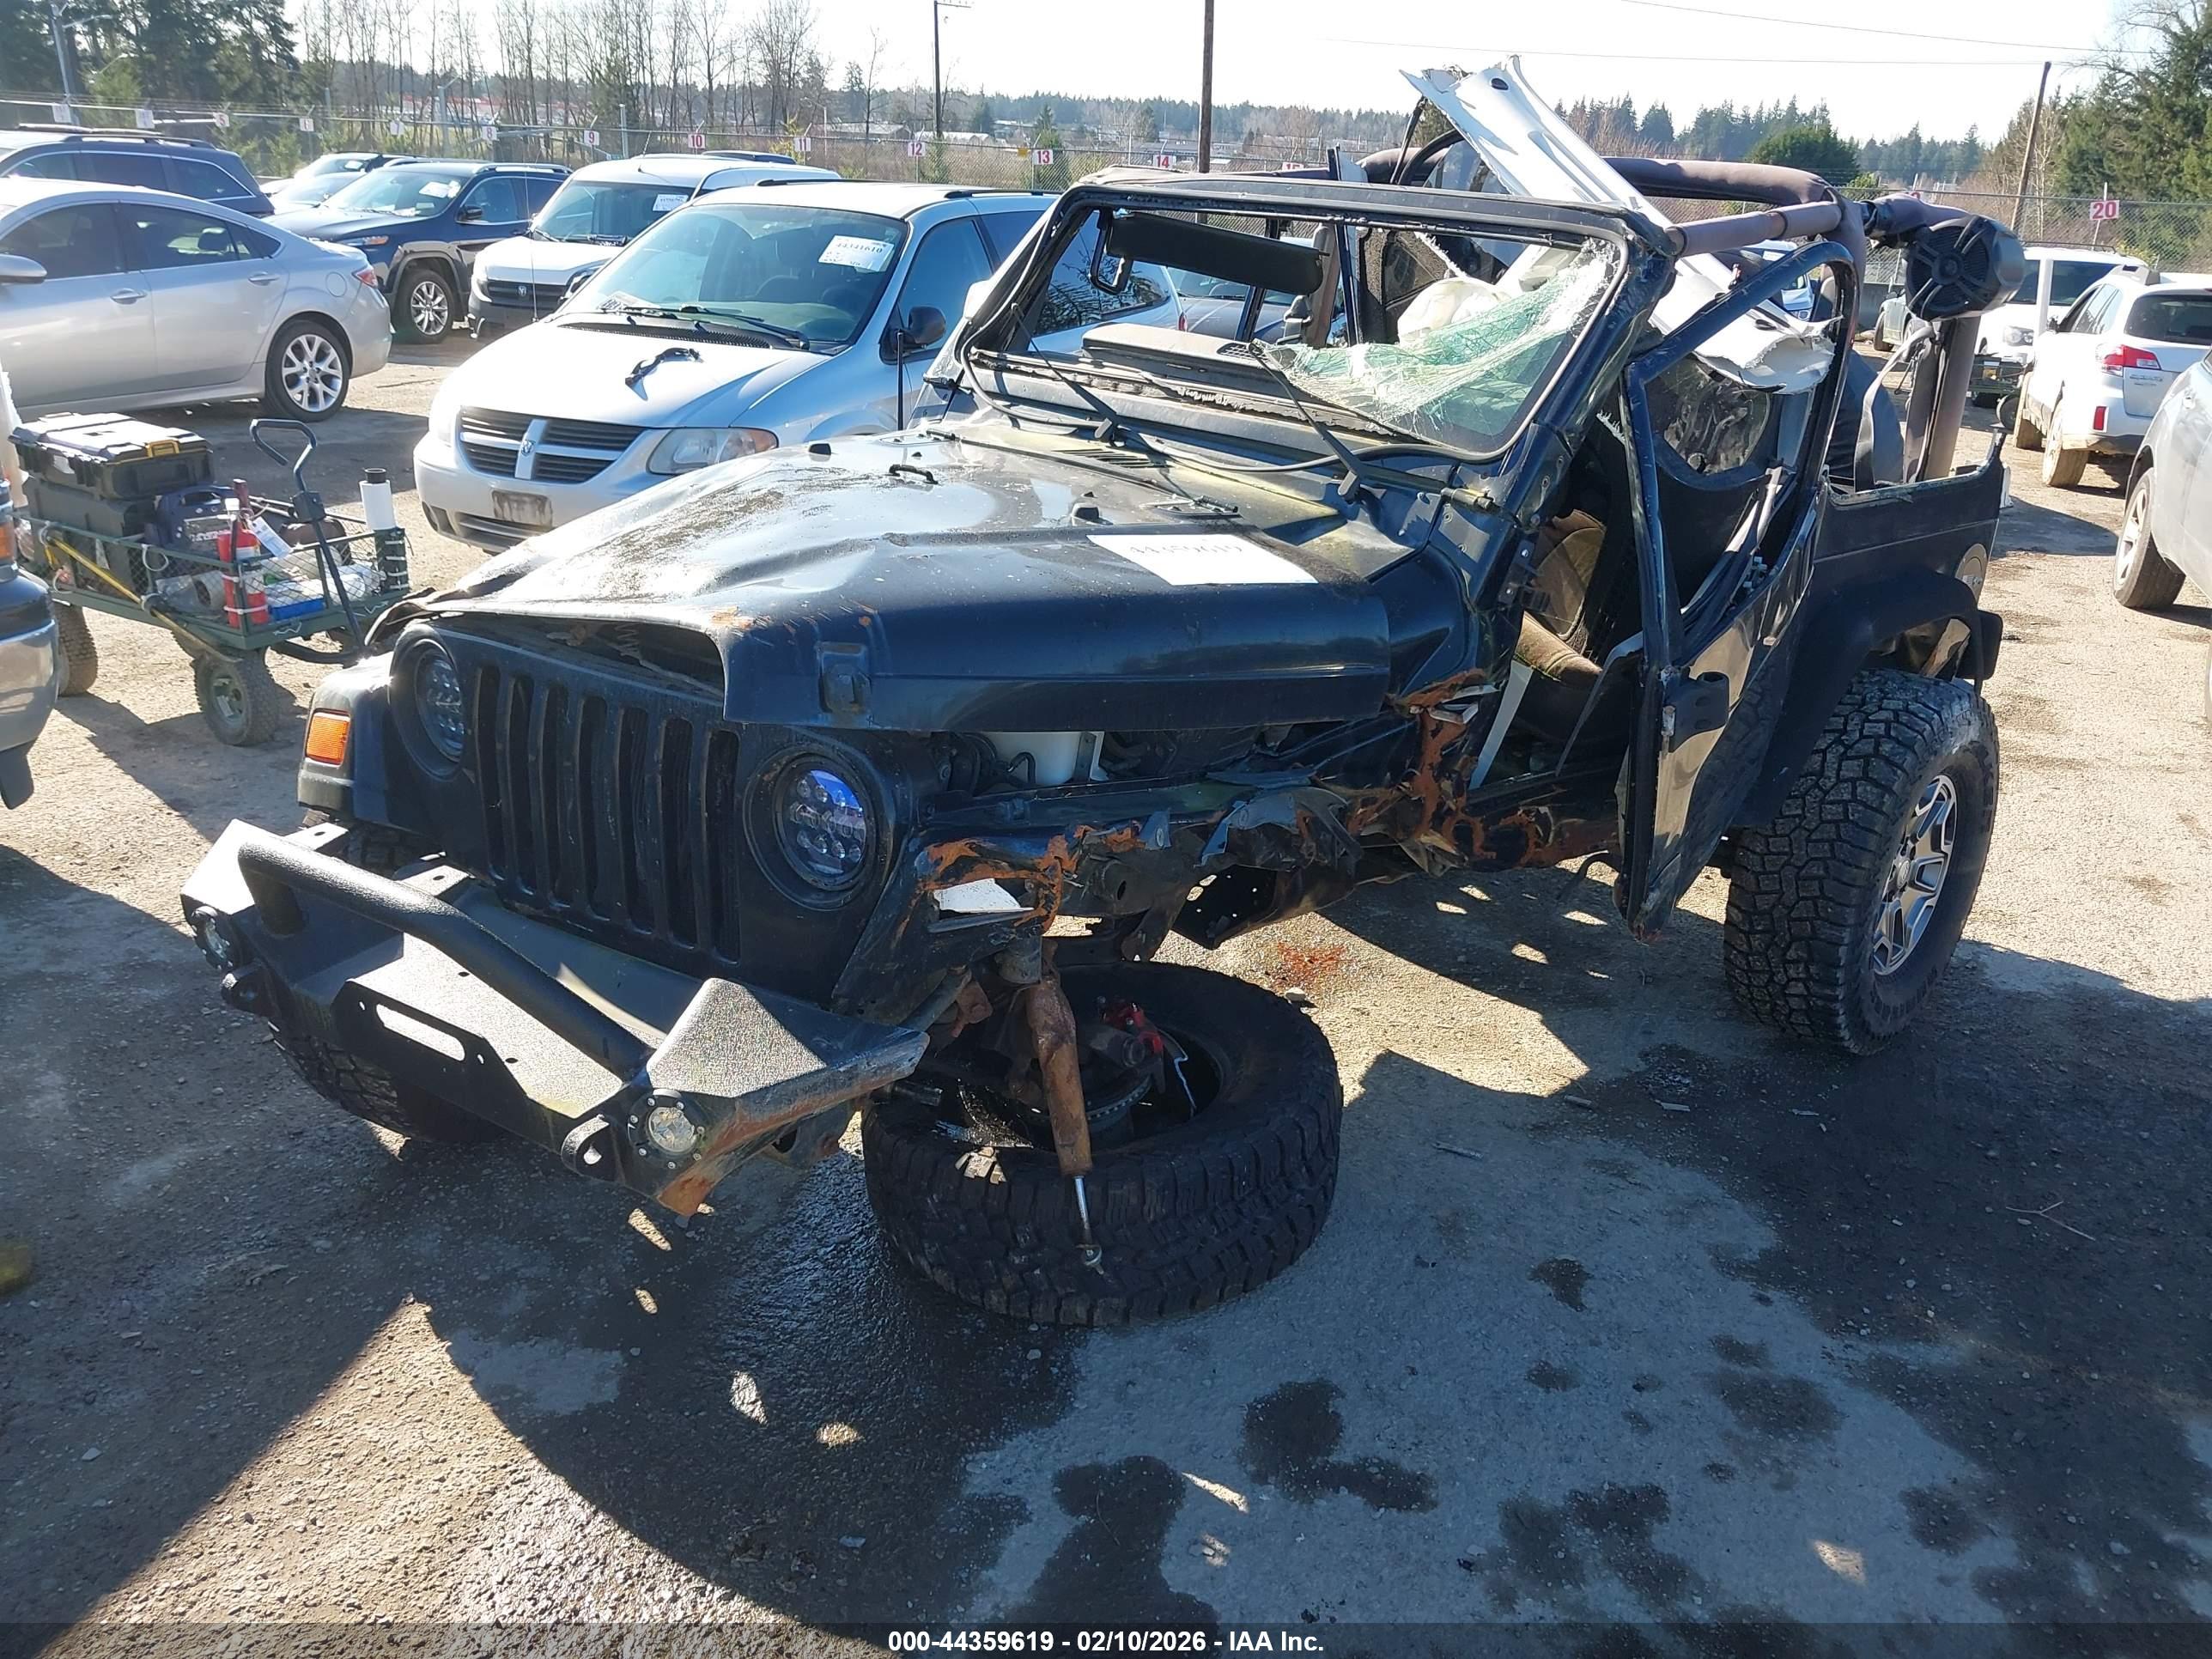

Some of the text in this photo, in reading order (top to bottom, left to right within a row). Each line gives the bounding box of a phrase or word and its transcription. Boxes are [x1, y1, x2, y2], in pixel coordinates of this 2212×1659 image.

[487, 127, 492, 138] 8
[589, 132, 594, 143] 9
[691, 135, 702, 147] 10
[799, 138, 806, 151] 11
[911, 143, 922, 156] 12
[1037, 150, 1050, 163] 13
[1157, 155, 1169, 168] 14
[2093, 202, 2117, 219] 20
